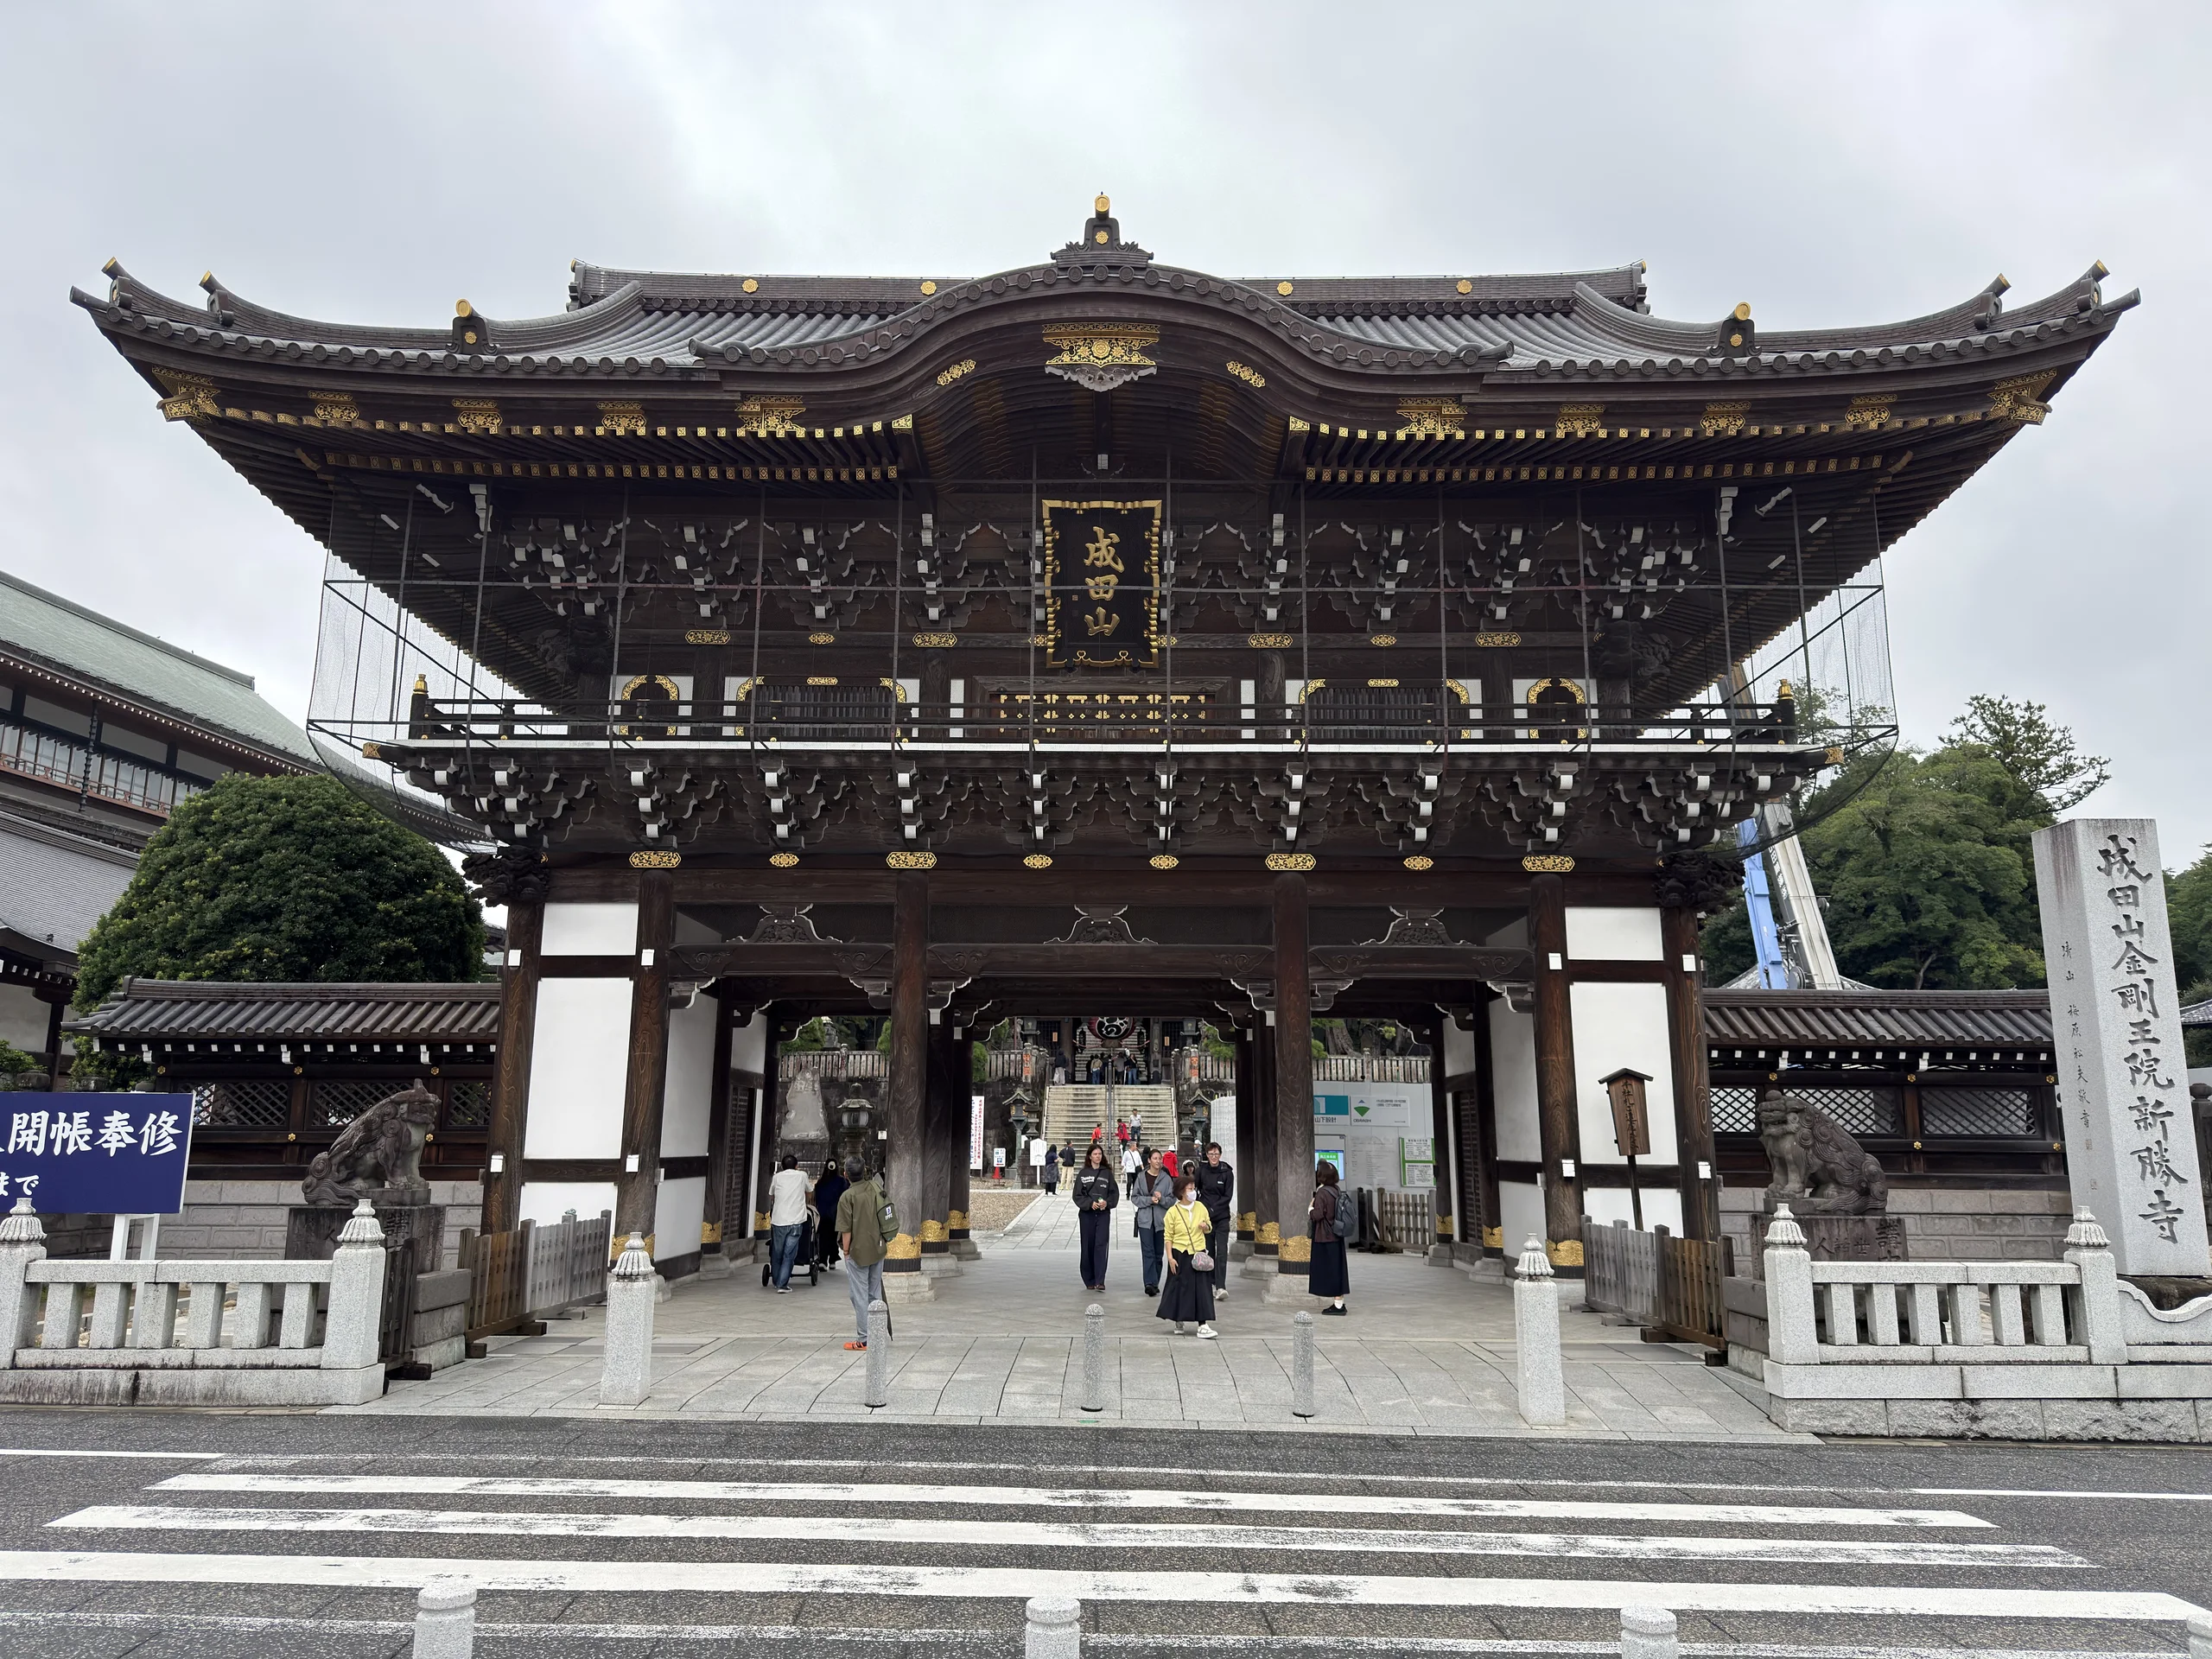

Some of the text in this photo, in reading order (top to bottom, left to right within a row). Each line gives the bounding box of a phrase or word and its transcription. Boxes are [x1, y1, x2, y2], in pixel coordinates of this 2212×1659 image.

[1084, 526, 1125, 637] 成田山
[2096, 835, 2189, 1244] 成田山金剛王院新勝寺
[0, 1110, 182, 1157] 開帳奉修
